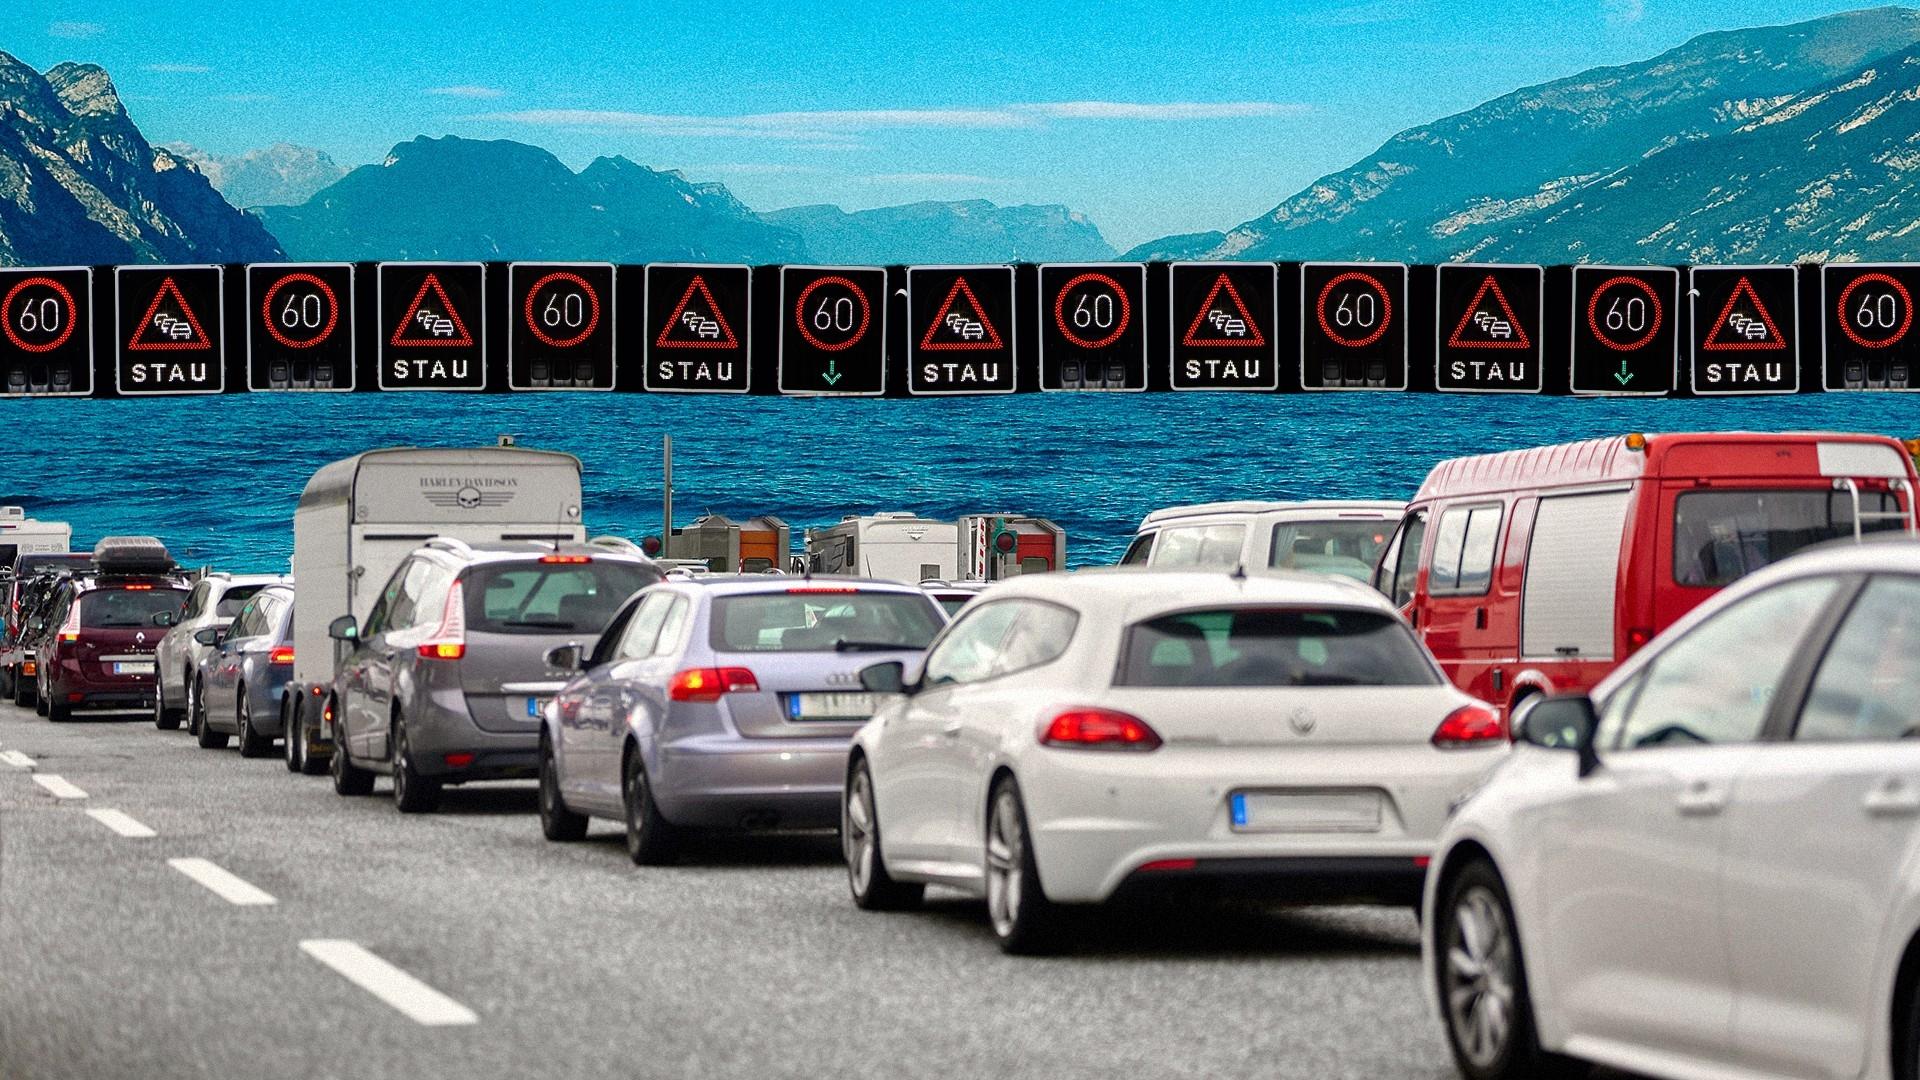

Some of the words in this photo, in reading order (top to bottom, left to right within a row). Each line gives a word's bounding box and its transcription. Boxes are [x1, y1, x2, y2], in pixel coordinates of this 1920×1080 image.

[20, 299, 58, 331] 60
[282, 294, 320, 327] 60
[544, 294, 582, 327] 60
[815, 297, 852, 331] 60
[1074, 294, 1112, 327] 60
[1336, 294, 1374, 327] 60
[1607, 297, 1644, 331] 60
[1857, 294, 1895, 327] 60
[132, 363, 205, 382] STAU
[395, 360, 467, 378] STAU
[660, 362, 731, 380] STAU
[924, 363, 997, 382] STAU
[1187, 360, 1259, 378] STAU
[1452, 362, 1523, 380] STAU
[1707, 363, 1780, 382] STAU
